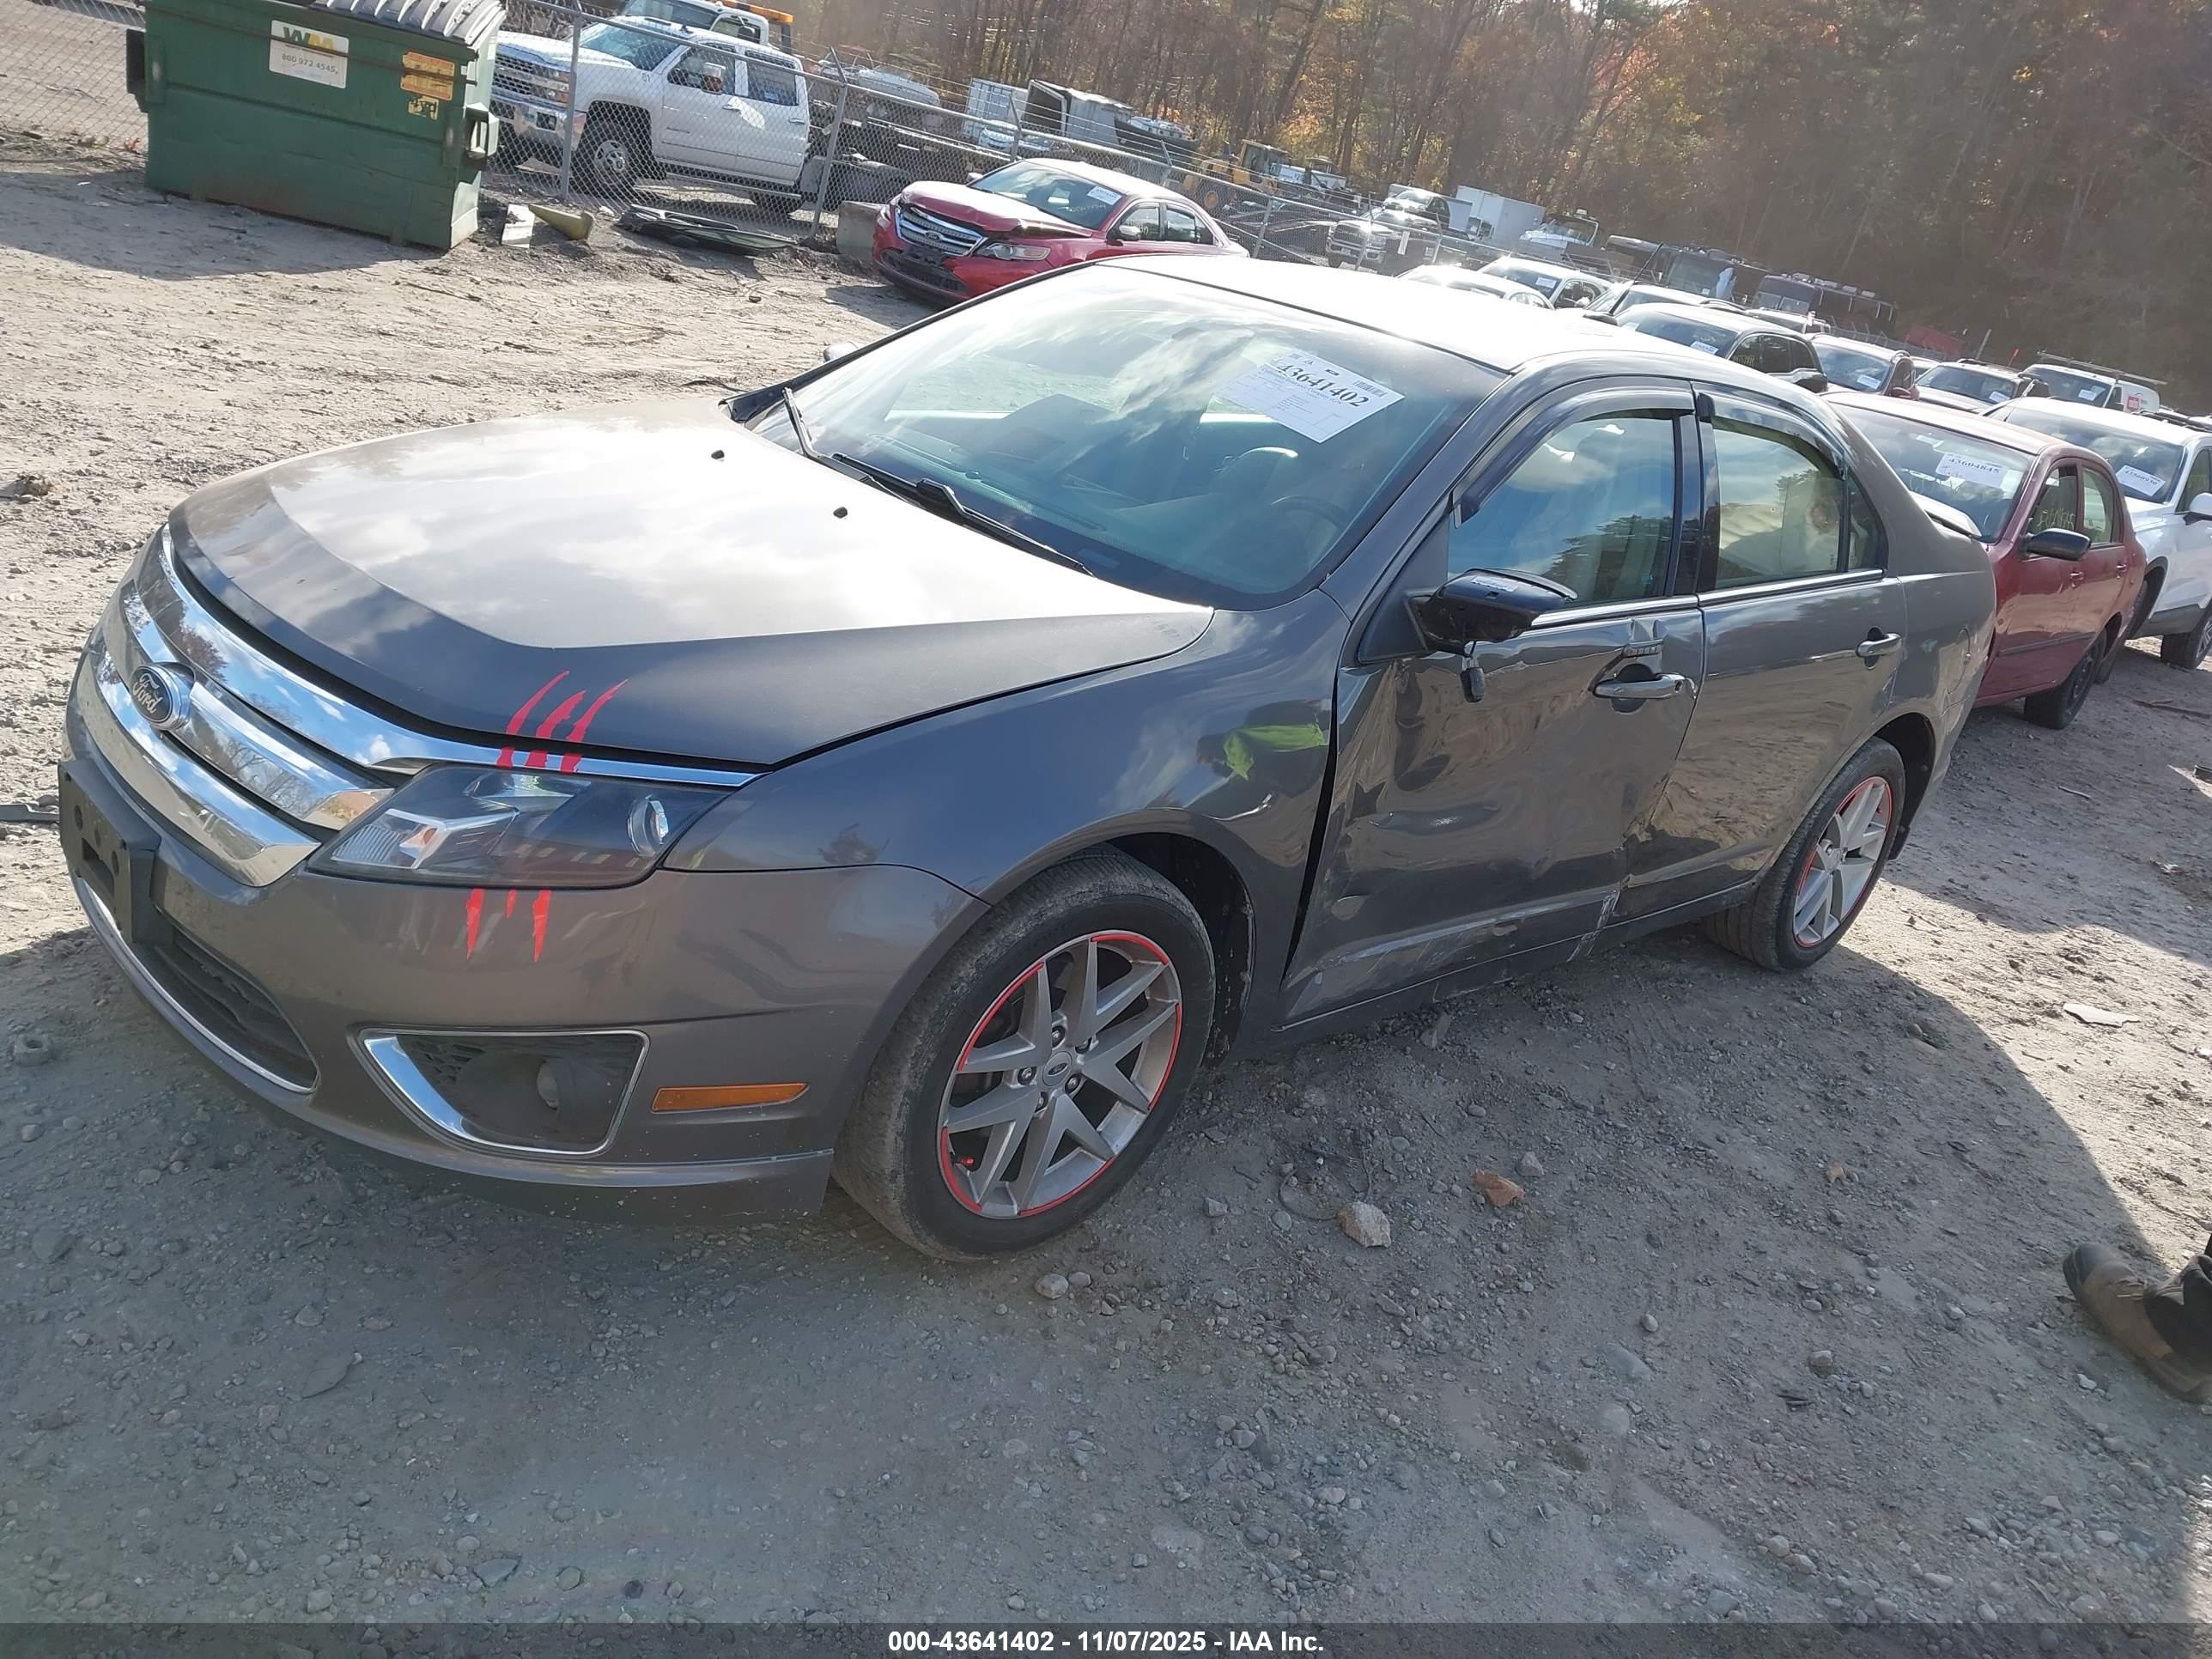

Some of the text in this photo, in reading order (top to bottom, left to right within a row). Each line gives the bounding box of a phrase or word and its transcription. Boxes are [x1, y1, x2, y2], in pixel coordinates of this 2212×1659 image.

[282, 53, 297, 63] 800
[298, 58, 313, 67] 972
[1277, 364, 1370, 407] 43641402
[132, 672, 164, 714] Ford
